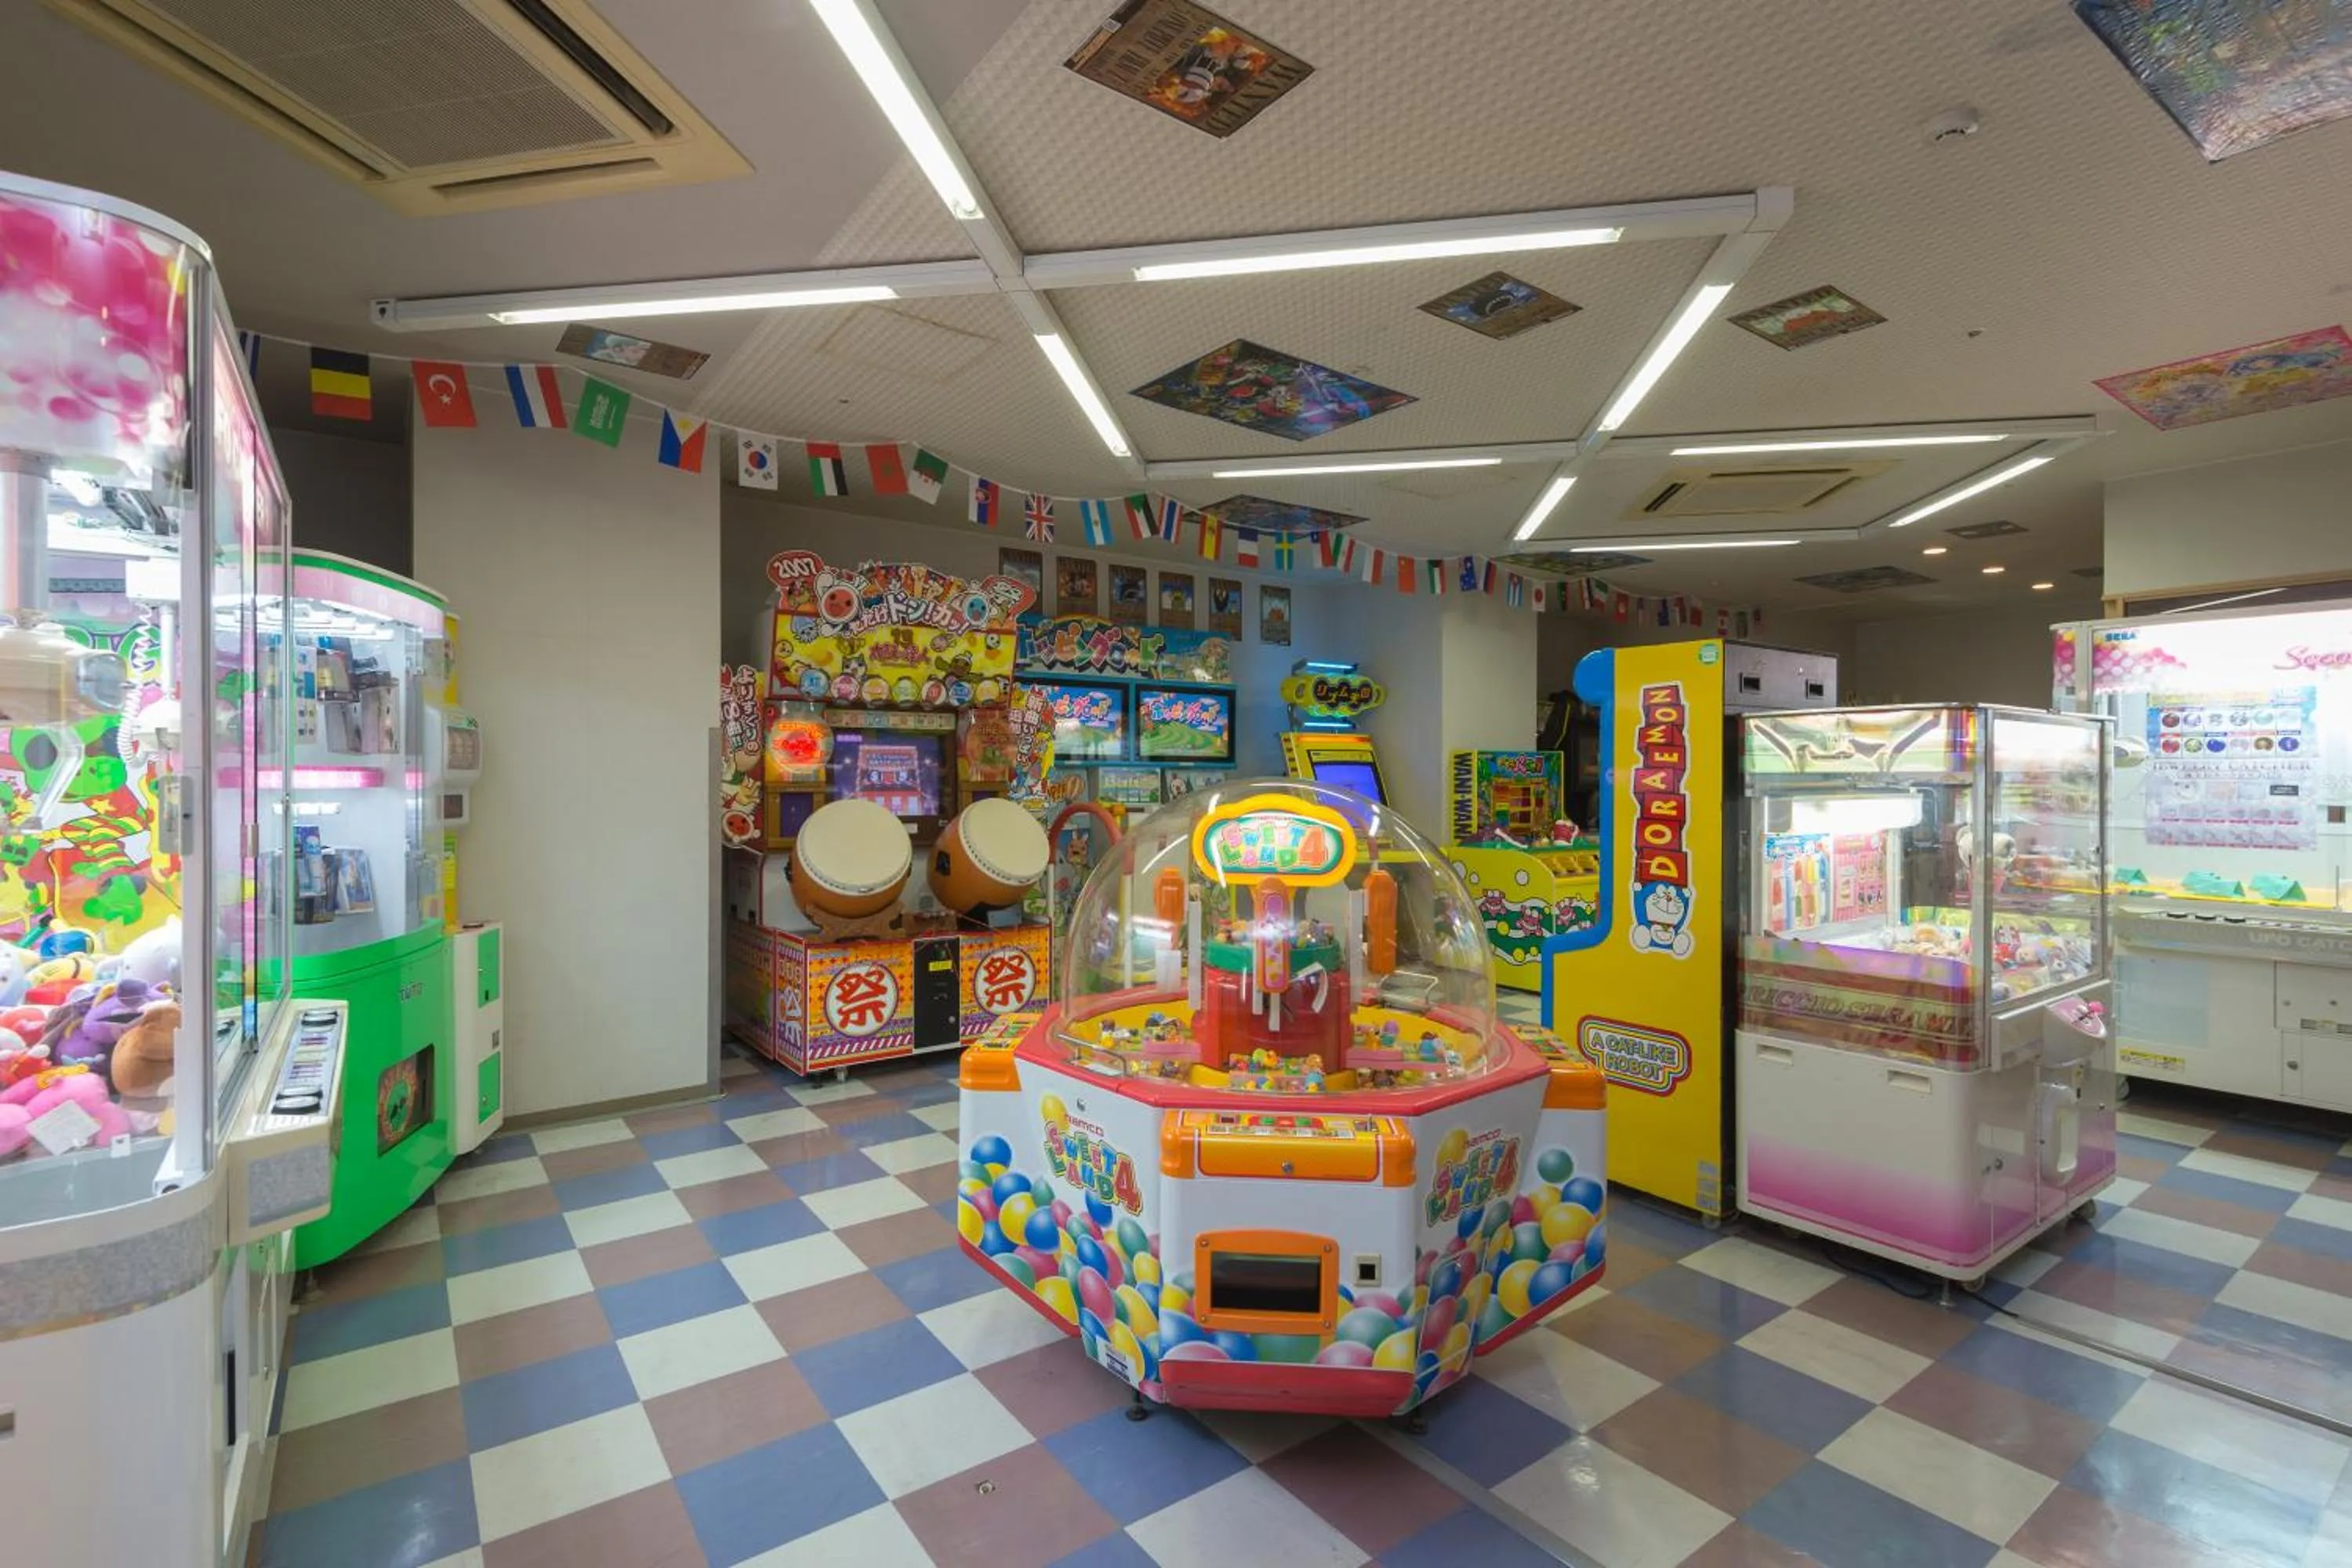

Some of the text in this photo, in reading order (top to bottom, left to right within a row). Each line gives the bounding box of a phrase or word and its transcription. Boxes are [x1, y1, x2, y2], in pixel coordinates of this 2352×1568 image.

[773, 557, 818, 579] 2007
[2105, 632, 2137, 642] SEGA
[1642, 687, 1679, 879] DORAEMON
[1221, 821, 1305, 849] SWEET
[1221, 826, 1326, 868] LAND 4
[835, 969, 888, 1029] 祭
[982, 954, 1029, 1008] 祭
[1591, 1031, 1605, 1050] A
[1605, 1052, 1660, 1081] ROBOT
[1045, 1120, 1117, 1173] SWEET
[1044, 1142, 1142, 1217] LAND 4
